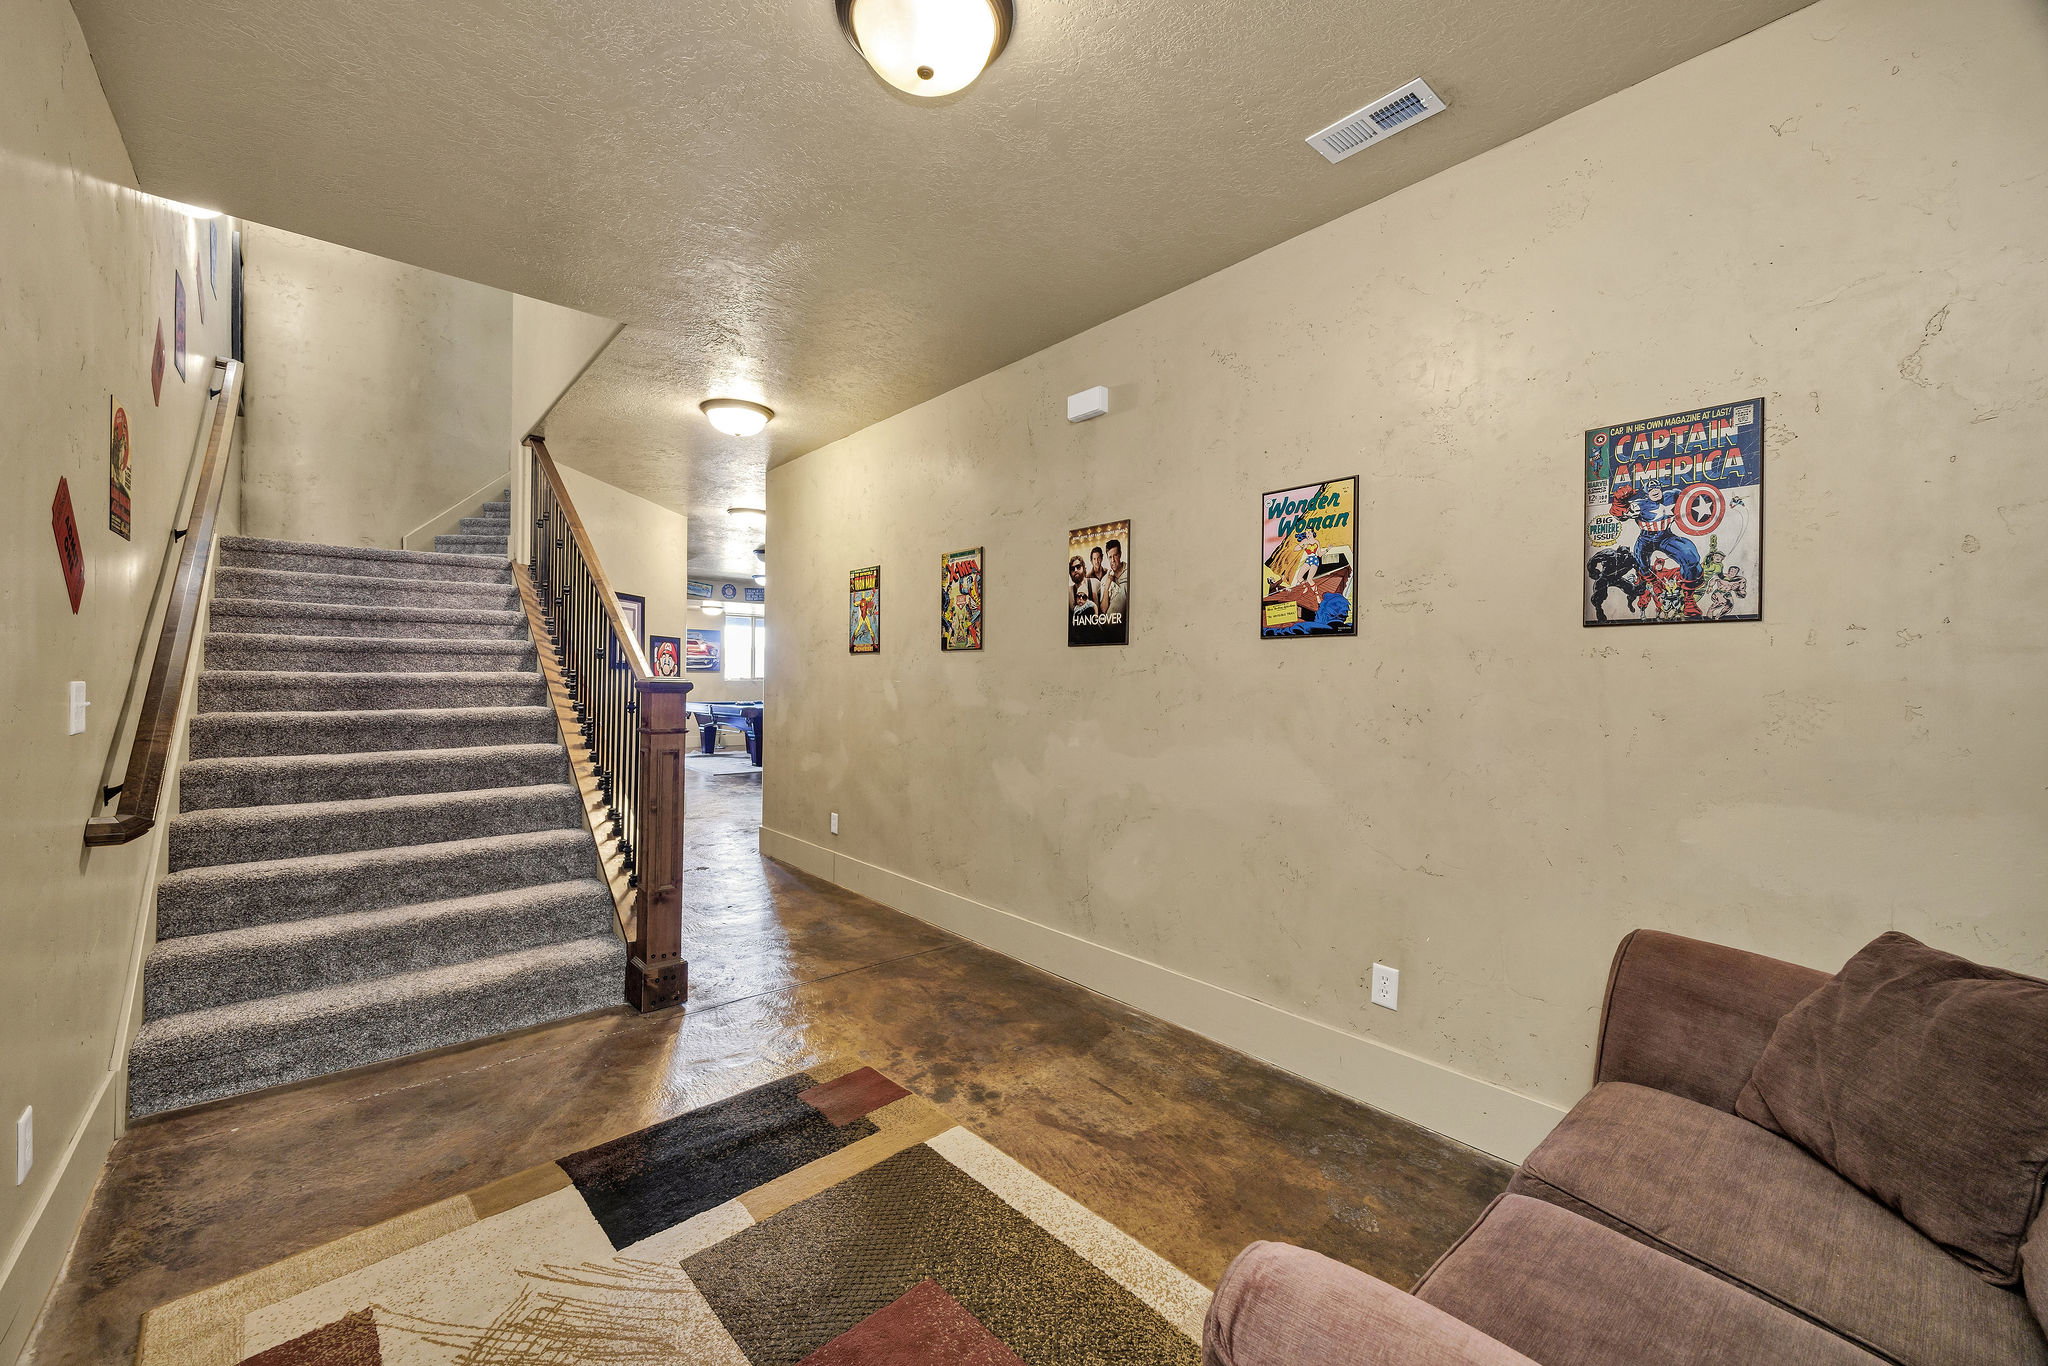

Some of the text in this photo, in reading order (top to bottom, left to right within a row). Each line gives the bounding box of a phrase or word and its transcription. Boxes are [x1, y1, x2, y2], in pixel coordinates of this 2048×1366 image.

[1626, 424, 1634, 434] IN
[1634, 422, 1646, 432] HIS
[1646, 419, 1664, 430] OWN
[1664, 414, 1701, 426] MAGAZINE
[1702, 411, 1711, 420] AT
[1712, 406, 1733, 417] LAST!
[1615, 418, 1738, 463] CAPTAIN
[1610, 447, 1745, 495] AMERICA
[1268, 491, 1340, 519] Wonder
[1277, 511, 1350, 537] Woman
[1589, 522, 1619, 535] PREMIERE
[1596, 516, 1613, 524] BIG
[1594, 532, 1618, 540] ISSUE!
[945, 559, 979, 583] X-MEN
[1072, 612, 1122, 626] HANGOVER
